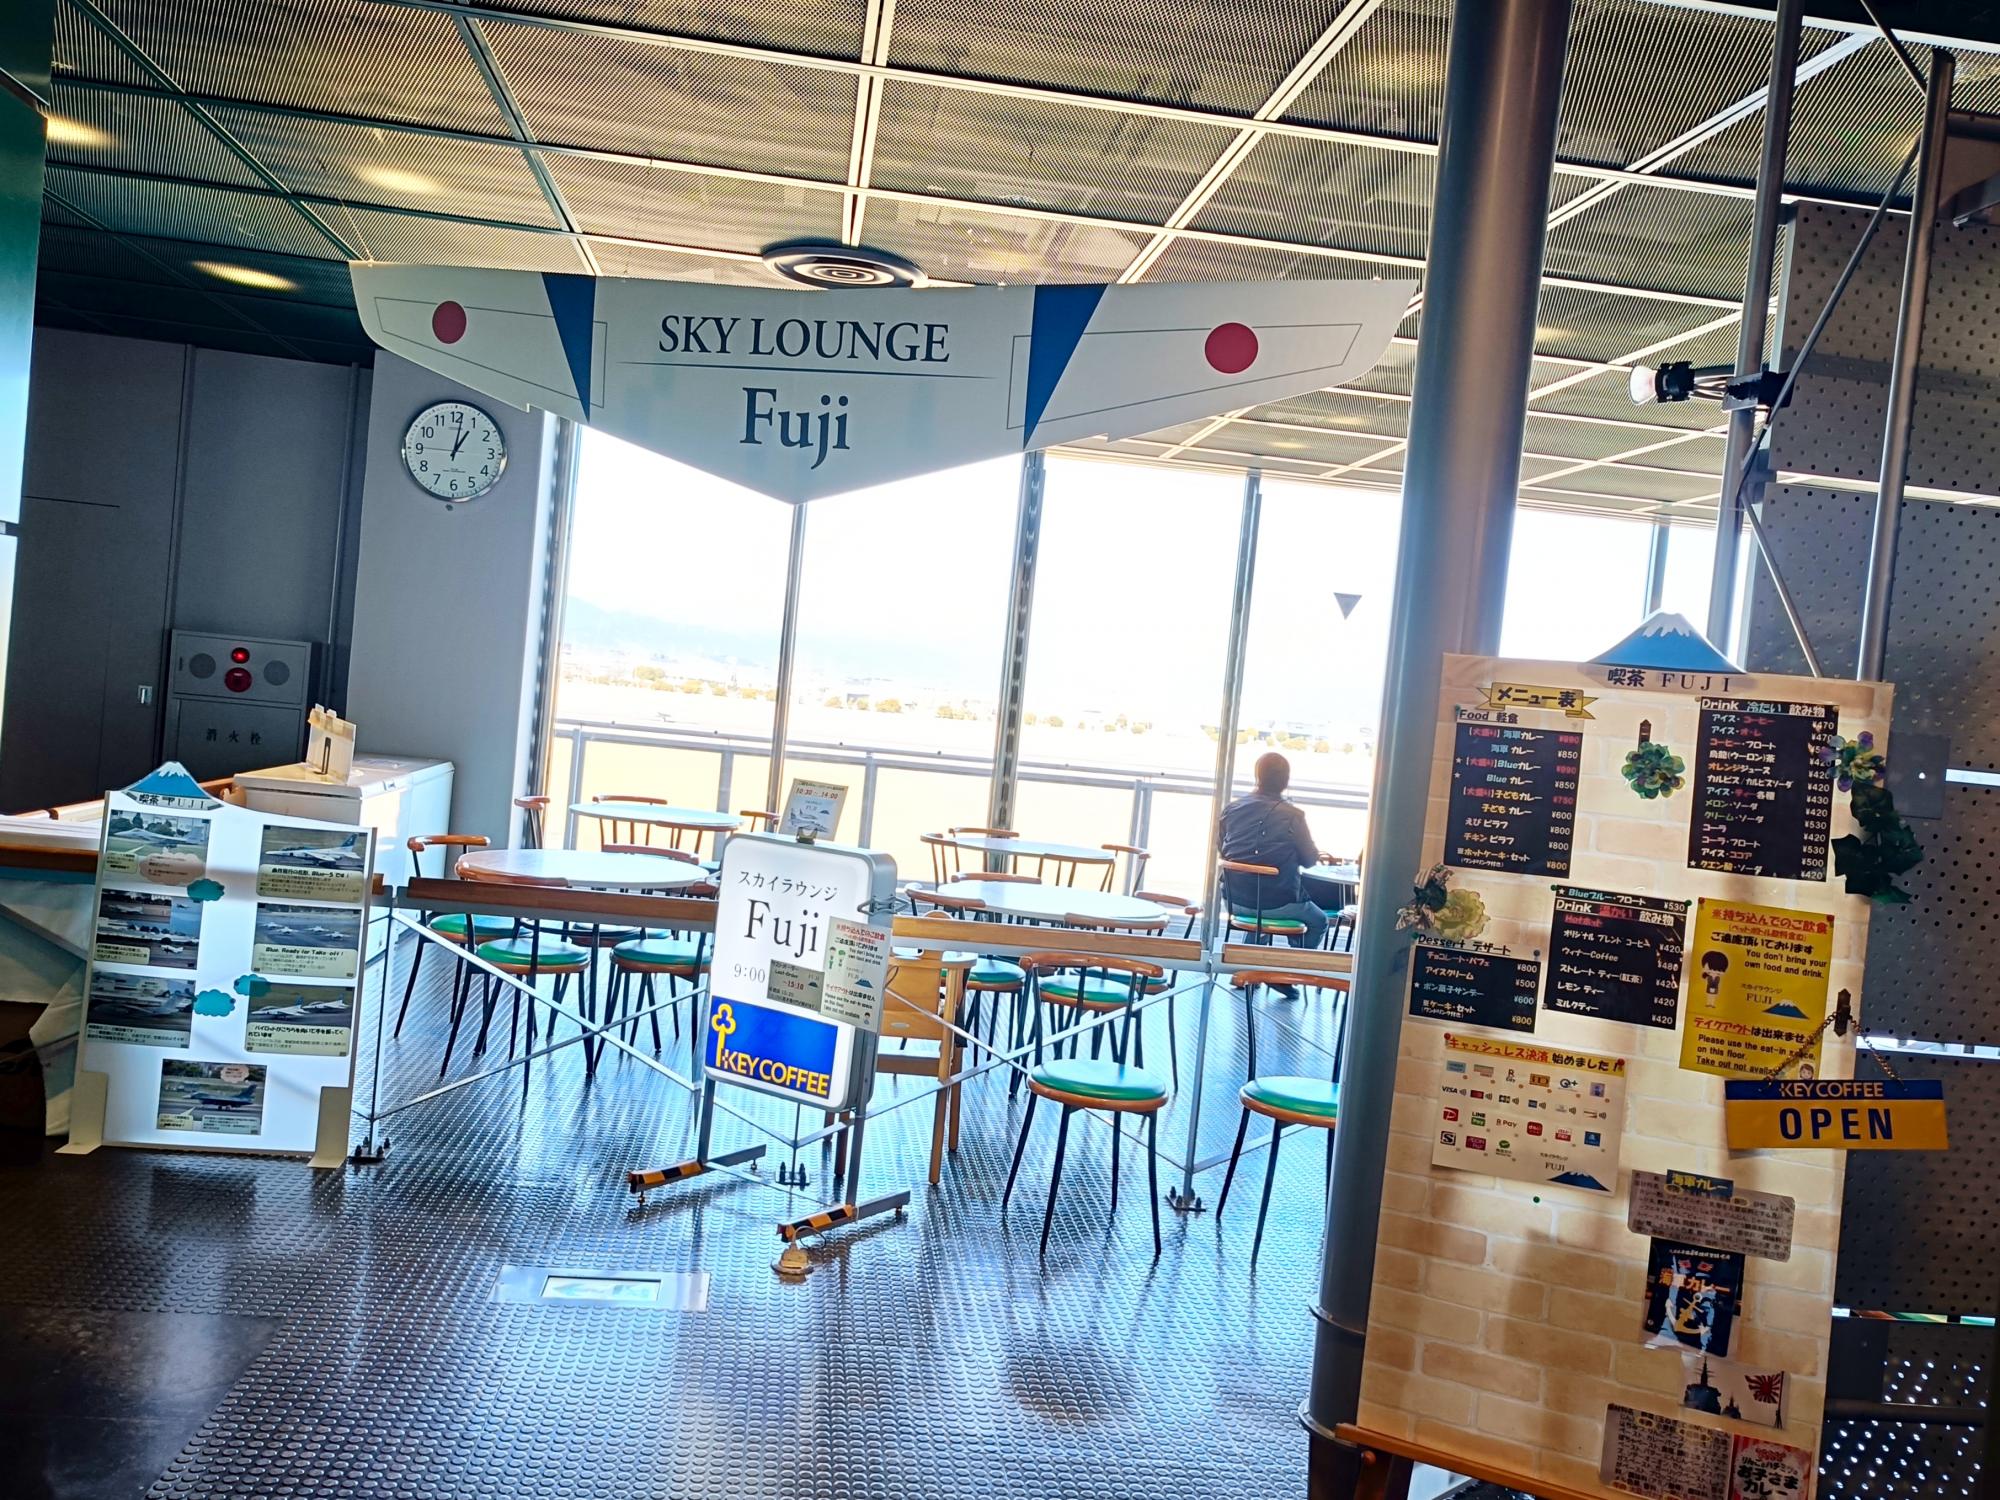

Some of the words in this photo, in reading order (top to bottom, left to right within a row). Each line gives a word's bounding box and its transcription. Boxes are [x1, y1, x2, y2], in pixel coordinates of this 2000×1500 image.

[659, 315, 741, 353] SKY
[749, 318, 950, 362] LOUNGE
[435, 415, 445, 427] 11
[450, 411, 464, 423] 12
[472, 417, 476, 428] 1
[421, 427, 434, 438] 10
[739, 387, 850, 470] Fuji
[482, 430, 490, 442] 2
[415, 443, 424, 455] 9
[487, 448, 495, 460] 3
[420, 460, 428, 472] 8
[480, 465, 488, 476] 4
[433, 474, 441, 485] 7
[450, 479, 458, 491] 6
[468, 477, 475, 488] 5
[1608, 668, 1646, 687] 喫茶
[1660, 672, 1730, 692] FUJI
[1497, 687, 1576, 708] メニュー表
[1702, 699, 1739, 710] Drink
[1746, 701, 1781, 713] 冷たい
[1789, 704, 1825, 717] 飲み物
[1460, 709, 1489, 720] Food
[1496, 712, 1519, 724] 軽食
[1511, 746, 1535, 755] カレー
[1558, 750, 1578, 759] ¥850
[1487, 774, 1507, 783] Blue
[1510, 776, 1533, 785] カレー
[1555, 781, 1575, 789] ¥850
[1808, 783, 1829, 791] ¥420
[1807, 796, 1828, 804] ¥430
[1509, 807, 1532, 815] カレー
[1552, 811, 1572, 820] ¥600
[1806, 808, 1827, 817] ¥420
[1550, 827, 1570, 835] ¥800
[1805, 821, 1826, 829] ¥530
[1703, 824, 1726, 832] コーラ
[1804, 833, 1825, 842] ¥420
[1464, 833, 1487, 842] チキン
[1549, 842, 1569, 850] ¥800
[1803, 846, 1824, 854] ¥530
[1546, 861, 1567, 870] ¥800
[1802, 858, 1823, 867] ¥500
[1801, 871, 1822, 879] ¥420
[739, 870, 837, 901] スカイラウンジ
[1556, 900, 1592, 913] Drink
[1639, 911, 1674, 926] 飲み物
[1664, 902, 1685, 911] ¥530
[744, 898, 819, 958] Fuji
[1473, 941, 1511, 955] デザート
[1660, 945, 1680, 953] ¥420
[1747, 950, 1760, 958] You
[1764, 952, 1783, 961] don't
[1787, 955, 1806, 965] bring
[1810, 960, 1827, 968] your
[734, 963, 765, 983] 9:00
[1517, 964, 1537, 973] ¥800
[1764, 962, 1782, 972] food
[1785, 966, 1799, 975] and
[1802, 969, 1824, 979] drink.
[1426, 966, 1474, 980] アイスクリーム
[1515, 979, 1535, 988] ¥500
[1514, 995, 1534, 1005] ¥600
[1558, 981, 1581, 991] レモン
[1584, 985, 1604, 994] ティー
[1654, 997, 1674, 1006] ¥420
[1556, 999, 1599, 1011] ミルクティー
[1652, 1015, 1672, 1024] ¥420
[1512, 1015, 1532, 1025] ¥800
[1699, 1034, 1725, 1045] Please
[1728, 1040, 1742, 1048] use
[1745, 1041, 1758, 1050] the
[1761, 1044, 1787, 1055] eat-in
[1710, 1046, 1724, 1056] this
[1697, 1056, 1716, 1066] Take
[1718, 1058, 1731, 1068] out
[1734, 1062, 1747, 1072] not
[722, 1048, 759, 1076] KEY
[759, 1059, 830, 1096] COFFEE
[1779, 1082, 1813, 1097] KEY
[1816, 1082, 1884, 1097] COFFEE
[1779, 1107, 1893, 1140] OPEN
[1737, 1465, 1799, 1489] お子さま
[1743, 1479, 1788, 1495] カレー
